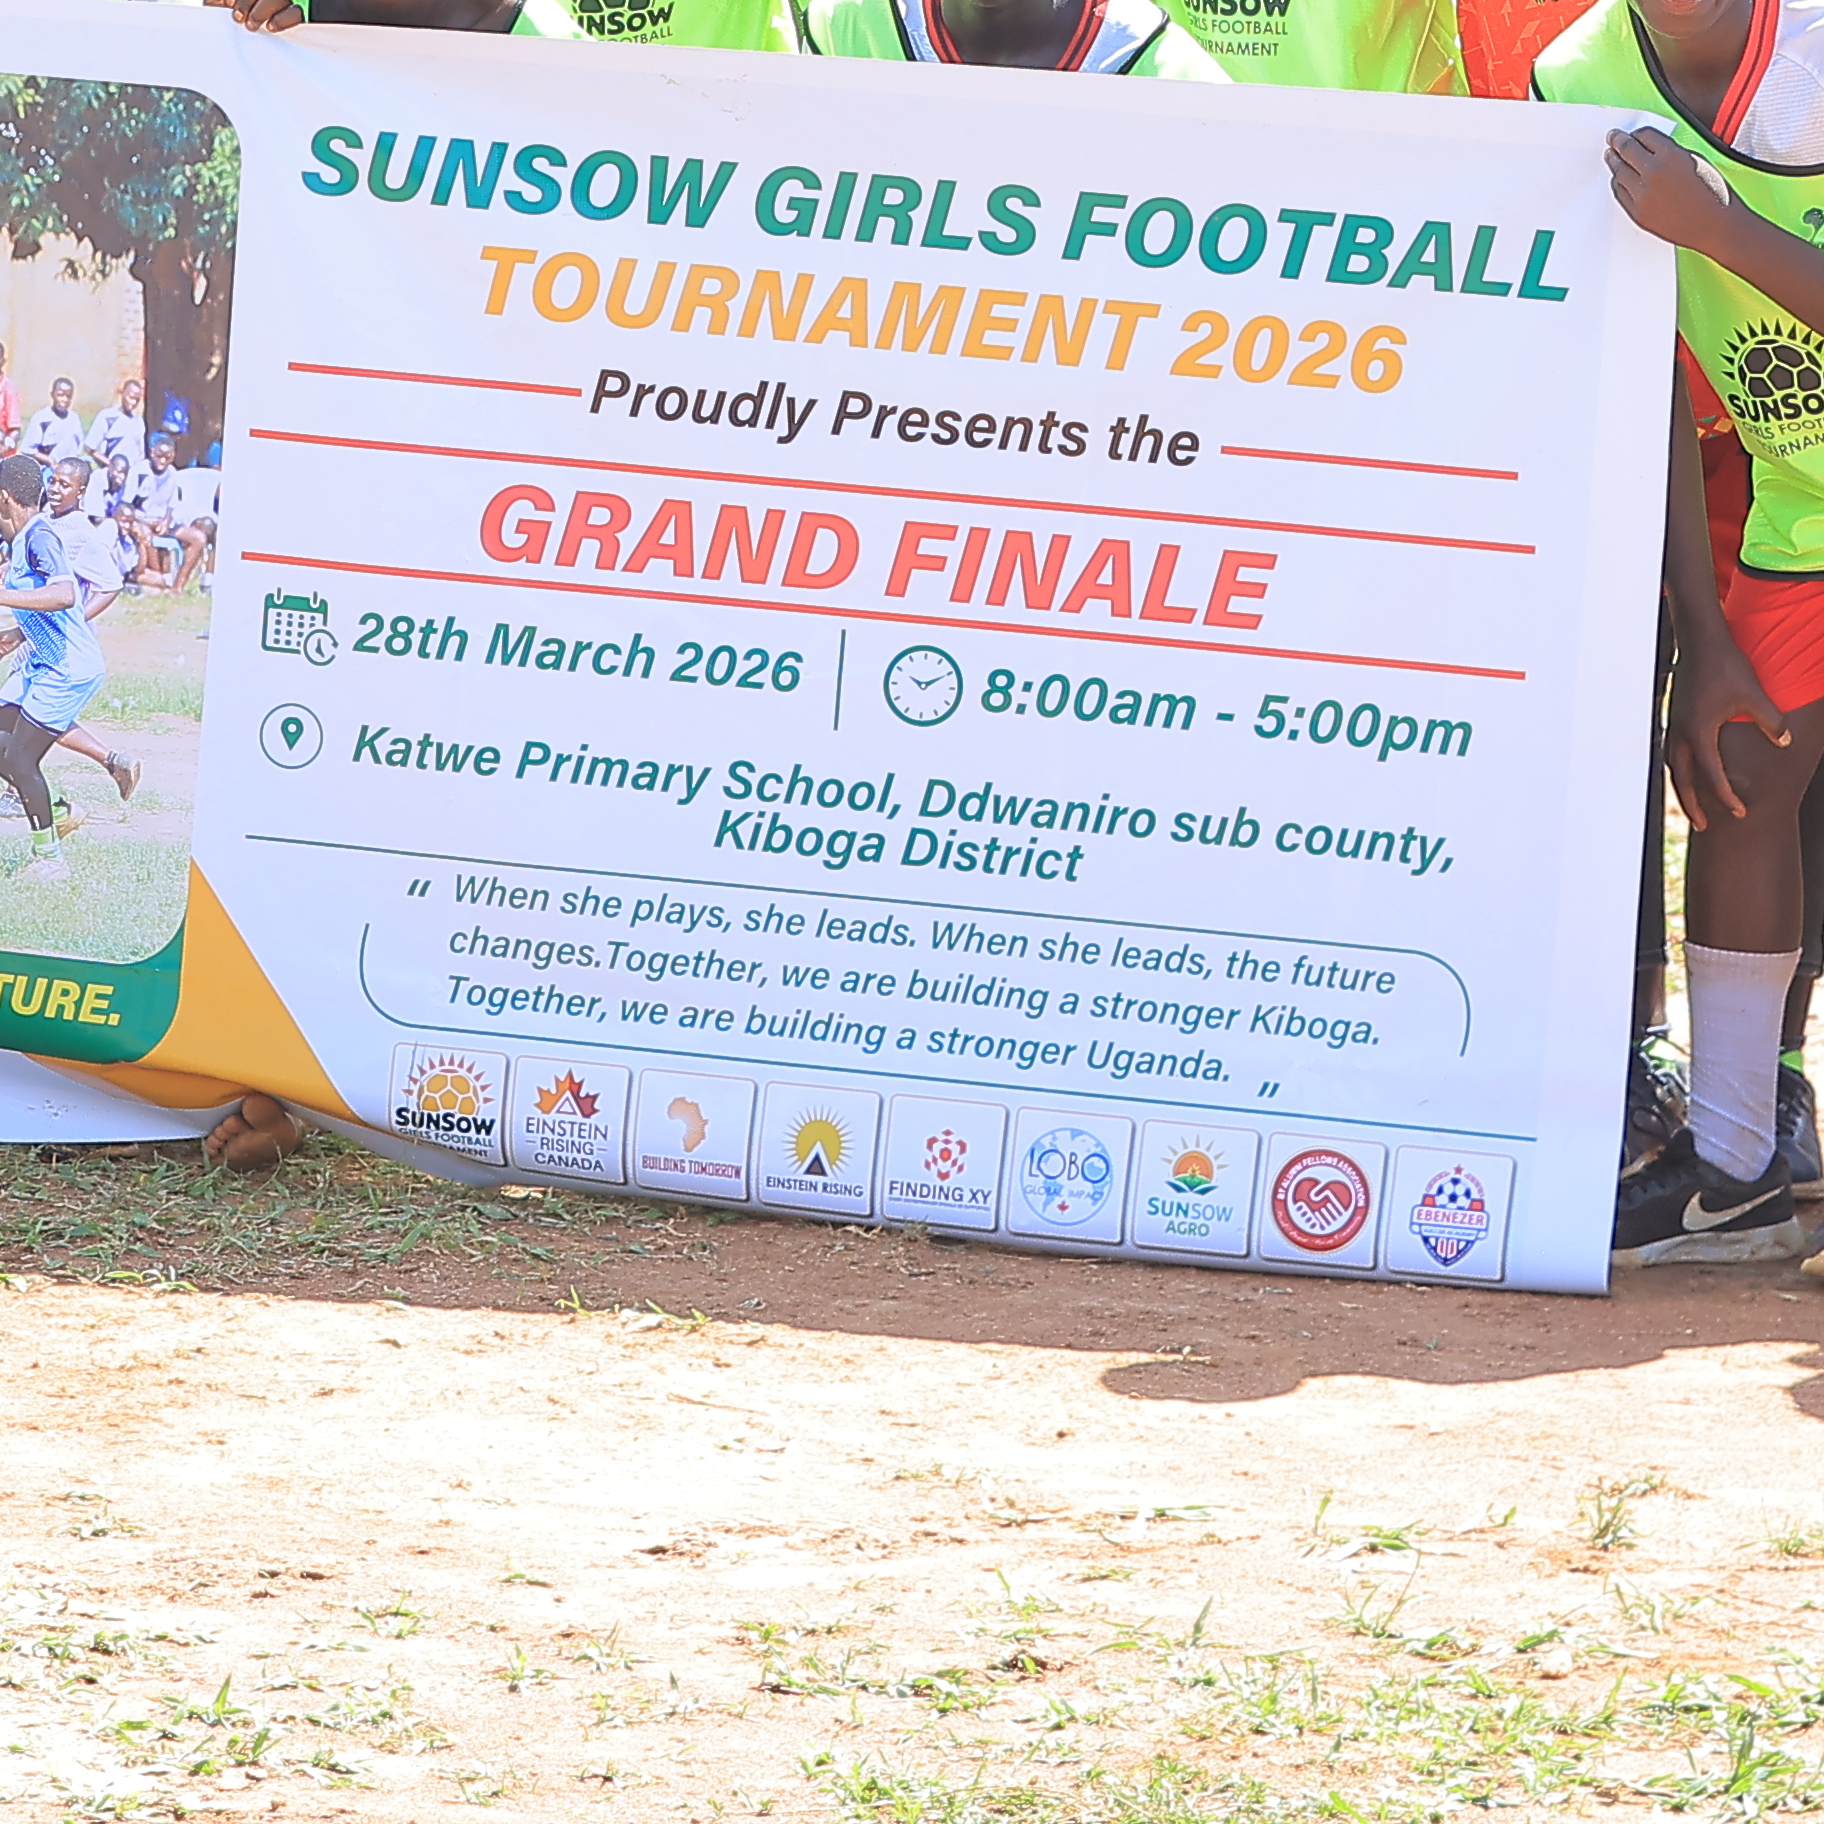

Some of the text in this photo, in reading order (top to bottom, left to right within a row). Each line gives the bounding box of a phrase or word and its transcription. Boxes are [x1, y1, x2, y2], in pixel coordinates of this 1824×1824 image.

[1212, 19, 1288, 35] FOOTBALL
[301, 126, 1570, 302] SUNSOW GIRLS FOOTBALL
[480, 246, 1407, 393] TOURNAMENT 2026
[589, 369, 1199, 466] Proudly Presents the
[480, 484, 1278, 630] GRAND FINALE
[352, 612, 804, 692] 28th March 2026
[981, 669, 1196, 730] 8:00am
[1254, 694, 1472, 762] 5:00pm
[352, 724, 1454, 876] Katwe Primary School, Ddwaniro sub county,
[713, 809, 1085, 882] Kiboga District
[456, 874, 1395, 994] When she plays, she leads. When she leads, the future
[782, 965, 830, 990] we
[840, 971, 896, 996] are
[906, 969, 1050, 1019] building
[1059, 993, 1080, 1015] a
[1090, 992, 1241, 1035] stronger
[1249, 1004, 1379, 1049] Kiboga.
[448, 975, 1229, 1082] Together, we are building a stronger Uganda.
[394, 1107, 496, 1136] SUNSOW
[526, 1117, 609, 1141] EINSTEIN
[434, 1132, 495, 1148] FOOTBALL
[540, 1137, 595, 1156] RISING
[534, 1152, 605, 1172] CANADA
[642, 1155, 743, 1179] BUILDING TOMORROW
[1028, 1147, 1110, 1184] LOBO
[766, 1176, 864, 1198] EINSTEIN RISING
[888, 1180, 964, 1202] FINDING
[967, 1189, 992, 1205] XY
[1146, 1197, 1234, 1223] SUNSOW
[1416, 1209, 1485, 1226] EBENEZER
[1164, 1221, 1210, 1237] AGRO
